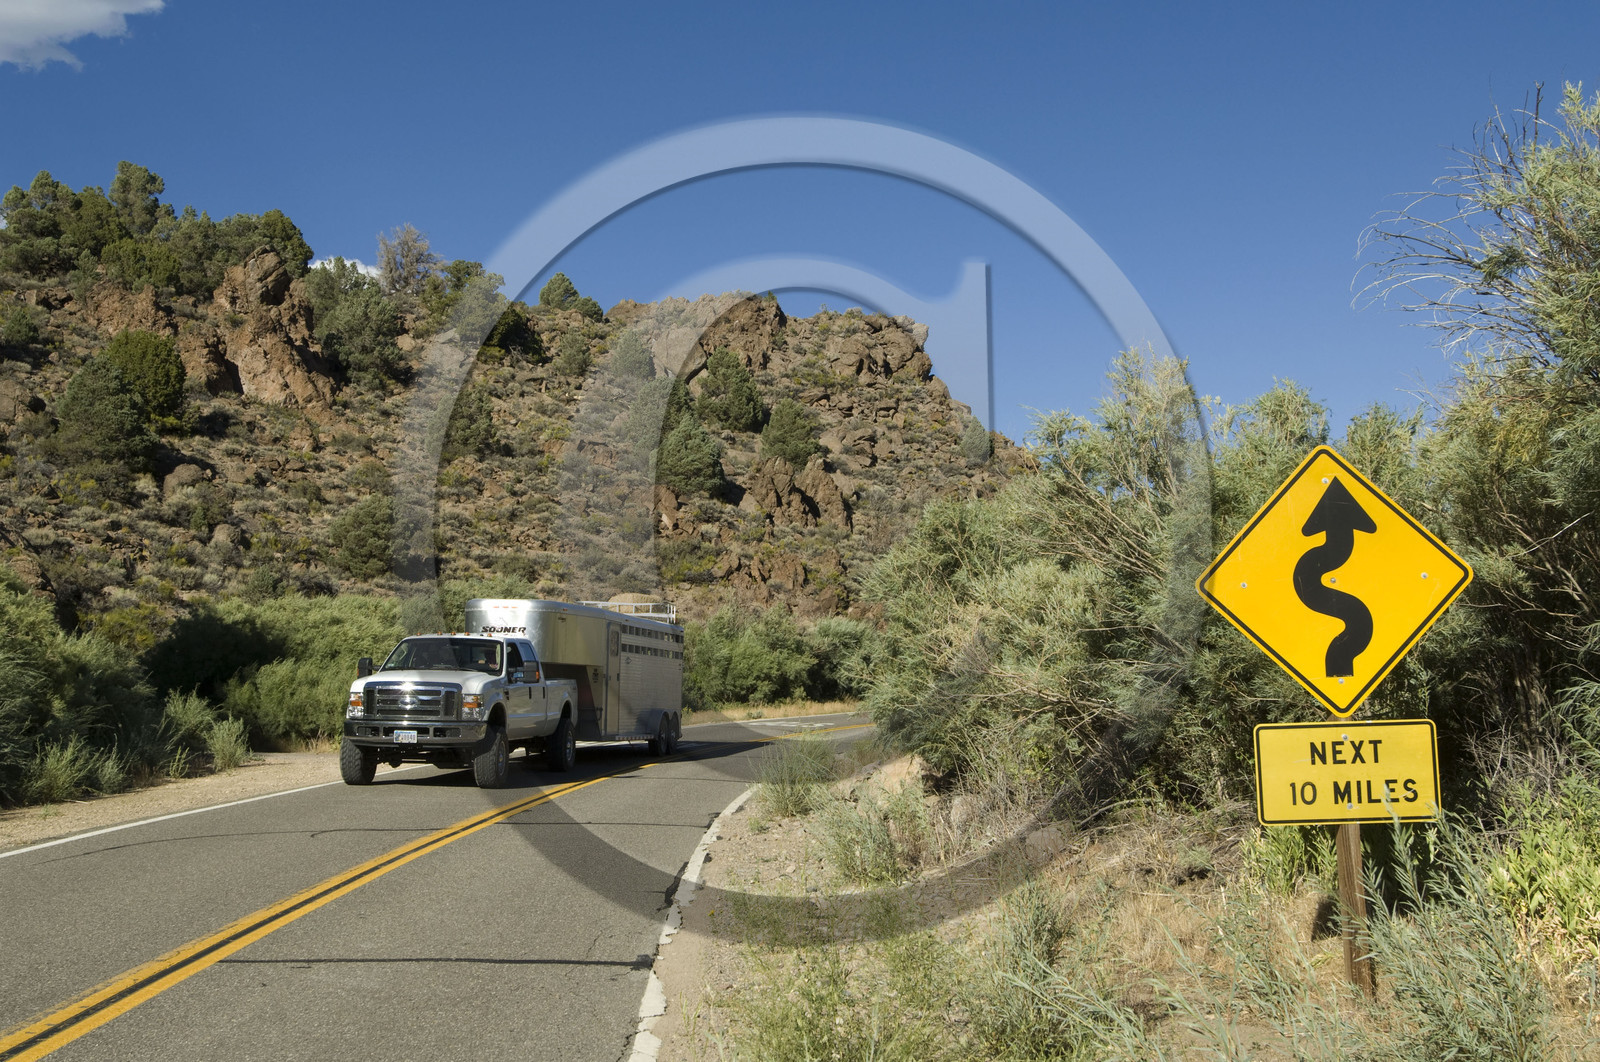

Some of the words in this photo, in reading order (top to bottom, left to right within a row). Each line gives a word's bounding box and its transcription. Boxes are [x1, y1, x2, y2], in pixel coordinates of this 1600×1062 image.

[1309, 739, 1382, 765] NEXT
[1289, 781, 1317, 806] 10
[1333, 778, 1418, 805] MILES
